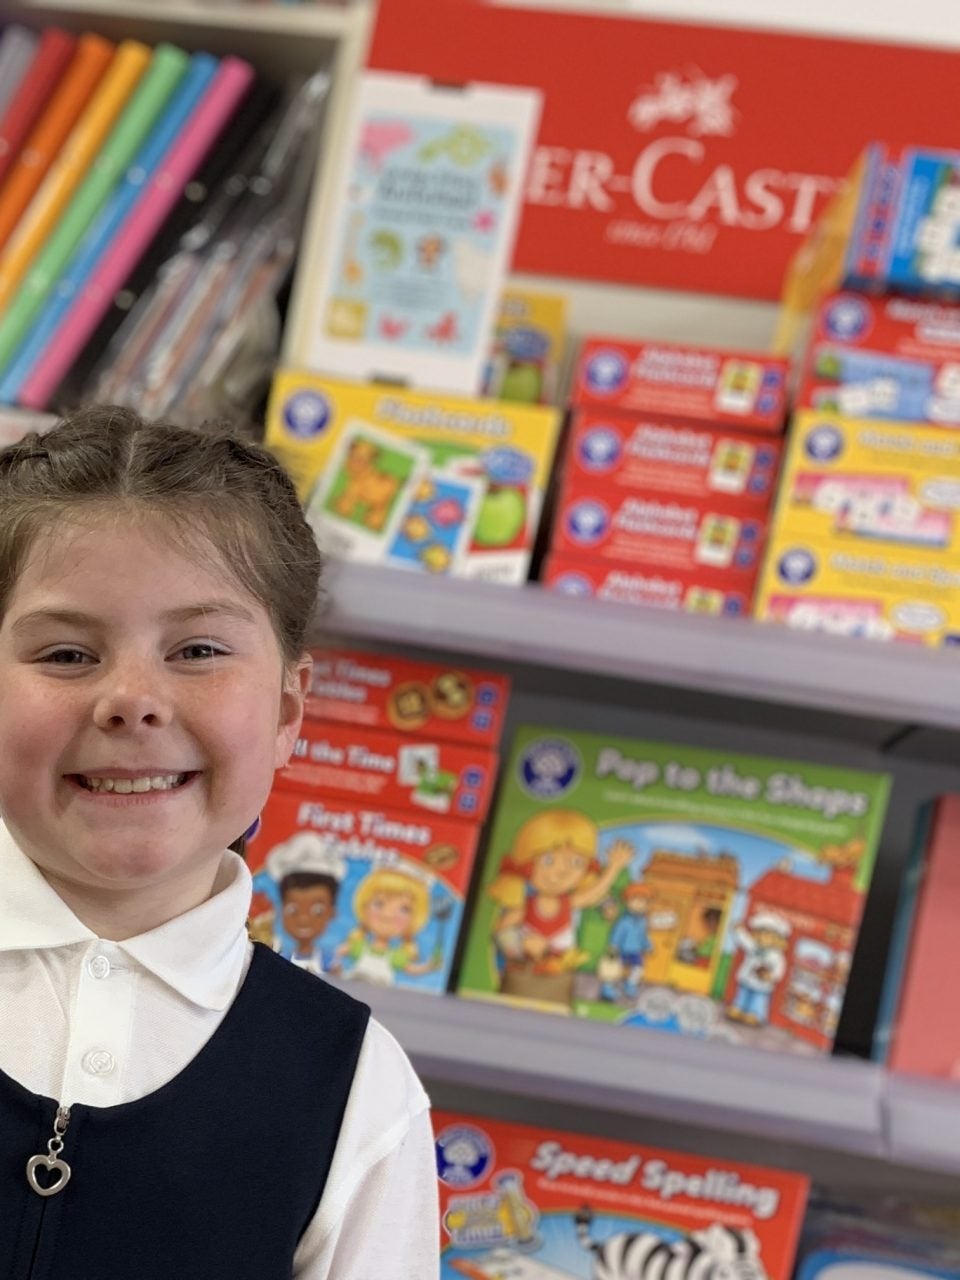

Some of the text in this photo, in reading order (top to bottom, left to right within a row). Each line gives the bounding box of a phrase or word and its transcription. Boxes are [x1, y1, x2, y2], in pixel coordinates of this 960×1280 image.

[527, 136, 850, 234] ER-CAST
[311, 741, 344, 764] the
[347, 745, 397, 775] Time
[595, 747, 660, 792] Pop
[664, 761, 701, 790] to
[706, 765, 761, 799] the
[766, 772, 869, 821] Shops
[297, 801, 432, 846] First Times
[531, 1141, 642, 1186] Speed
[642, 1159, 781, 1220] Spelling
